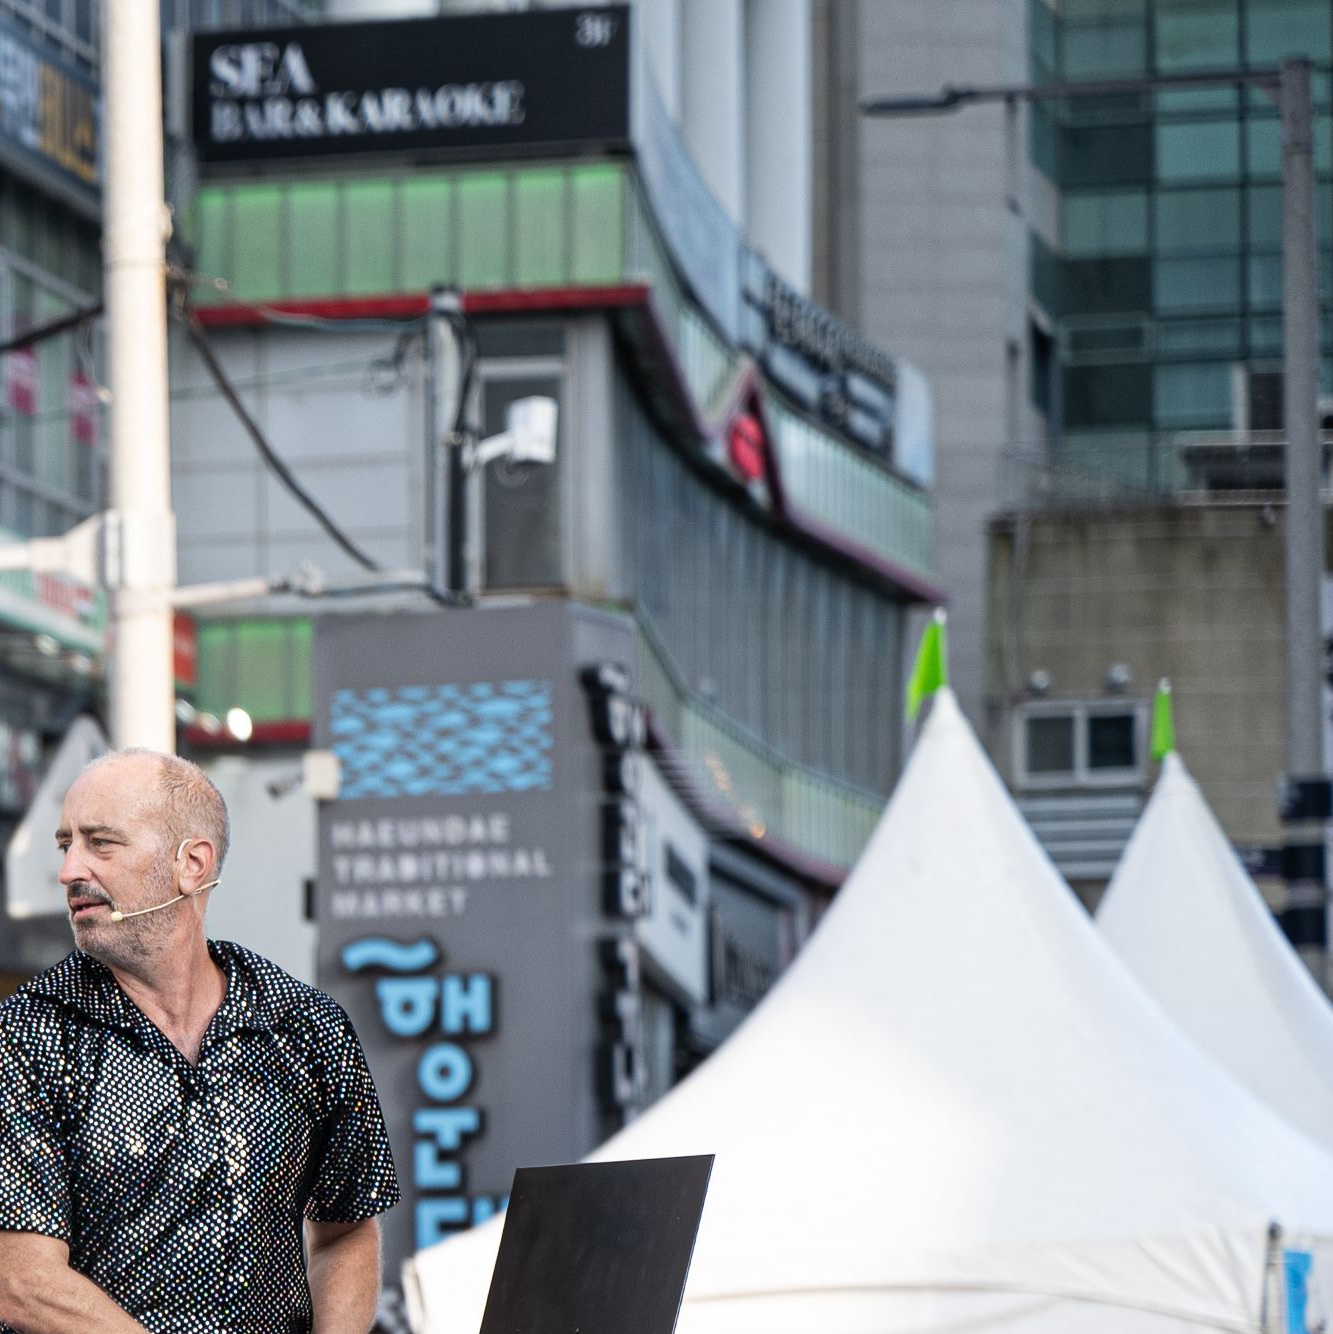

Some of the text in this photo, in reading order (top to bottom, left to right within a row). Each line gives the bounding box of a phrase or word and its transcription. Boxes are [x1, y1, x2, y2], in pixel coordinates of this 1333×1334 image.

[209, 42, 315, 97] SEA
[332, 813, 512, 848] HAEUNDAE
[333, 849, 553, 885] TRADITIONAL
[332, 886, 467, 919] MARKET
